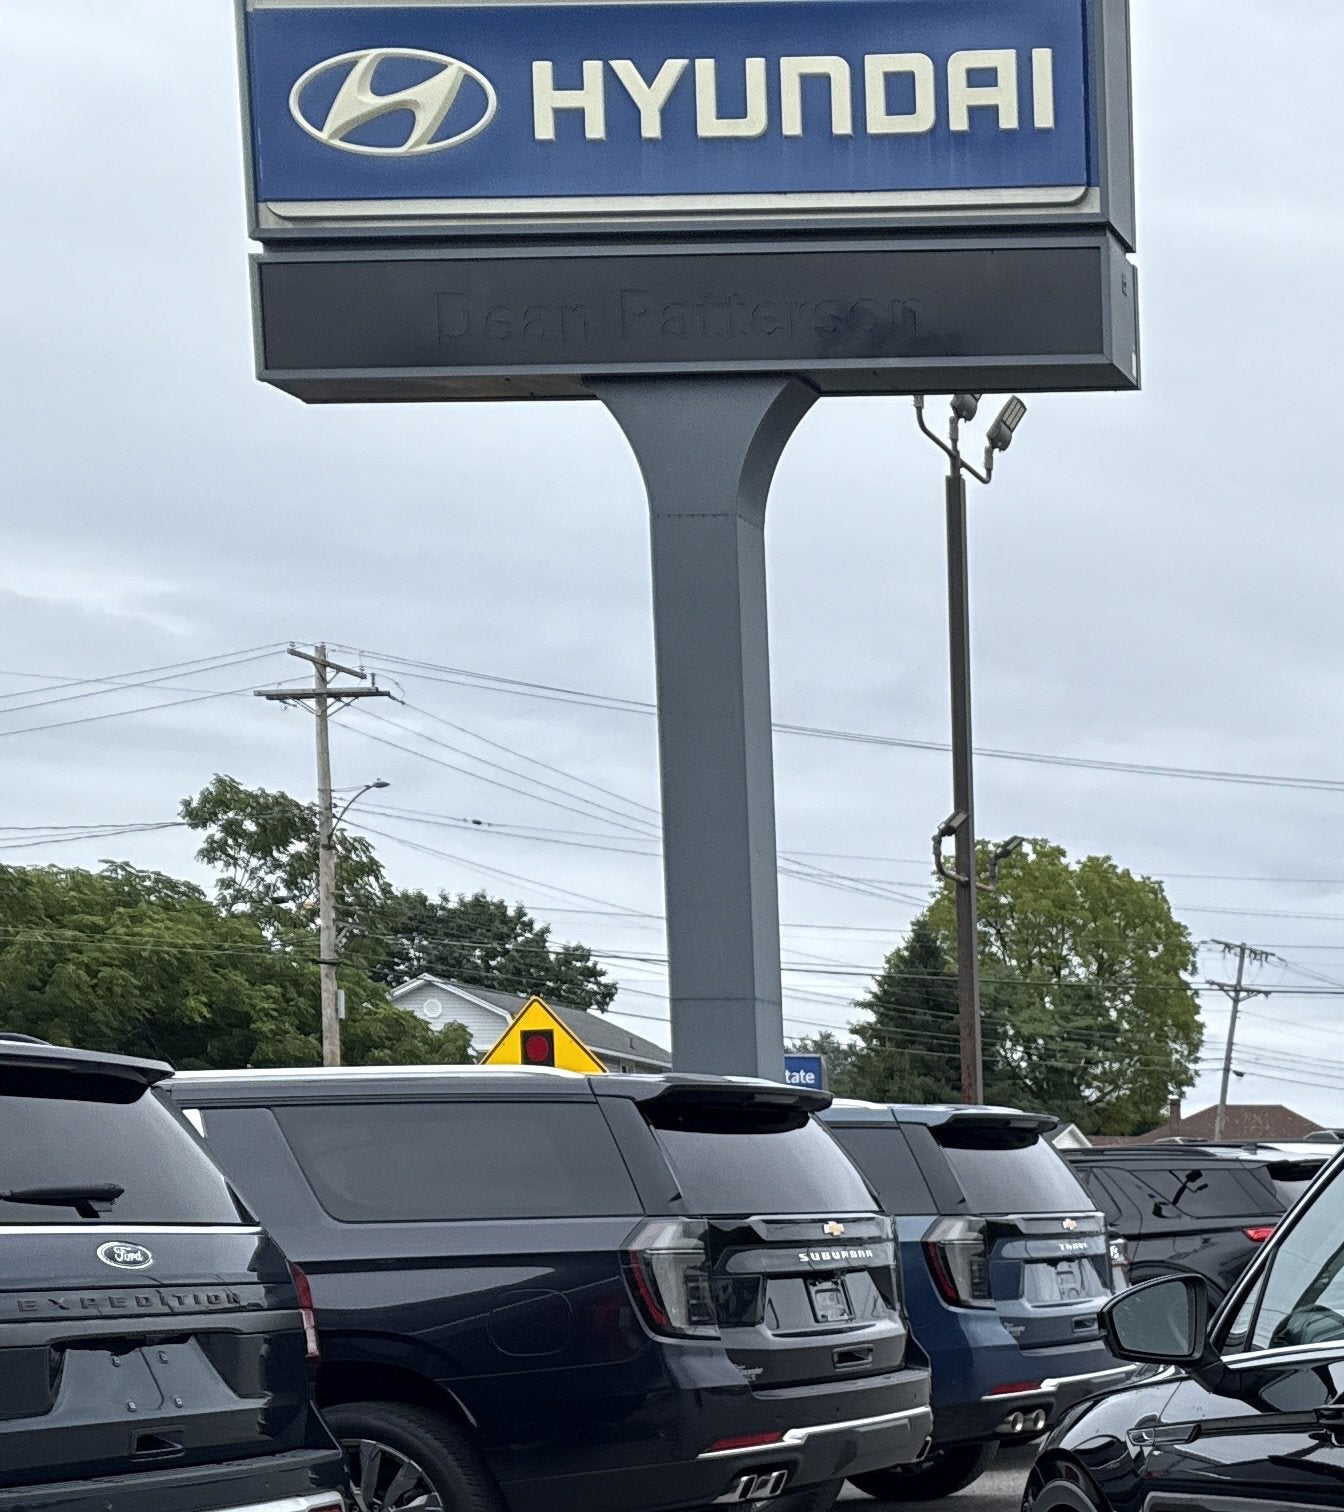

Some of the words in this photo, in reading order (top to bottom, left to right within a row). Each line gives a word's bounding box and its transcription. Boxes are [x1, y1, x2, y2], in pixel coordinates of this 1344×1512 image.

[532, 47, 1055, 142] HYUNDAI
[433, 291, 588, 343] Dean
[619, 287, 921, 341] Patterson
[784, 1069, 815, 1084] tate
[112, 1245, 144, 1263] Ford
[17, 1291, 241, 1312] EXPEDITION
